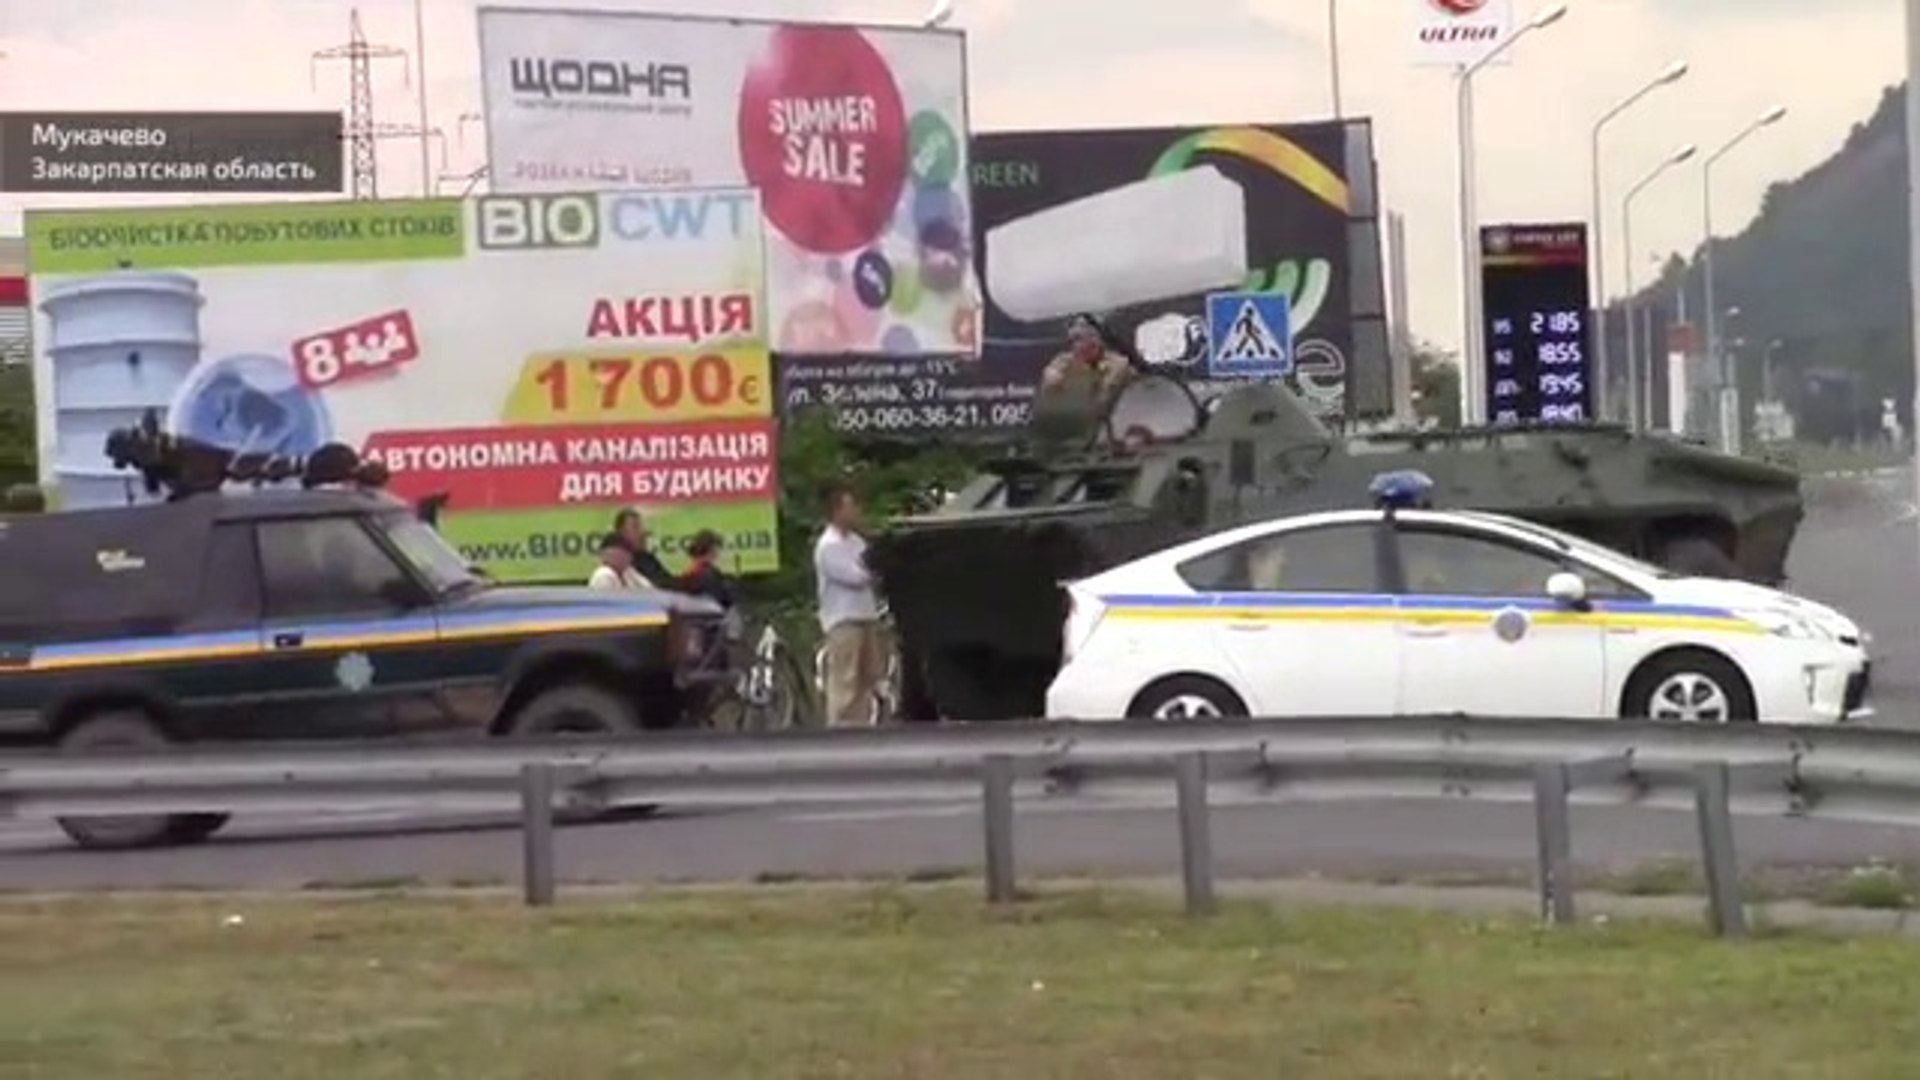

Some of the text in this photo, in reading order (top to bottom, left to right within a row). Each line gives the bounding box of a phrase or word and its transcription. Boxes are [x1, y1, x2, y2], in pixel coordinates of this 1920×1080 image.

[1419, 26, 1498, 42] ULTRA
[768, 95, 877, 134] SUMMER
[784, 132, 865, 186] SALE
[369, 214, 455, 238] СТОКІВ
[483, 193, 754, 245] BIO CWT
[587, 294, 753, 343] АКЦІЯ
[302, 339, 341, 382] 8
[911, 378, 937, 400] 37
[566, 432, 768, 463] КАНАЛІЗАЦІЯ
[560, 465, 769, 500] ДЛЯ БУДИНКУ
